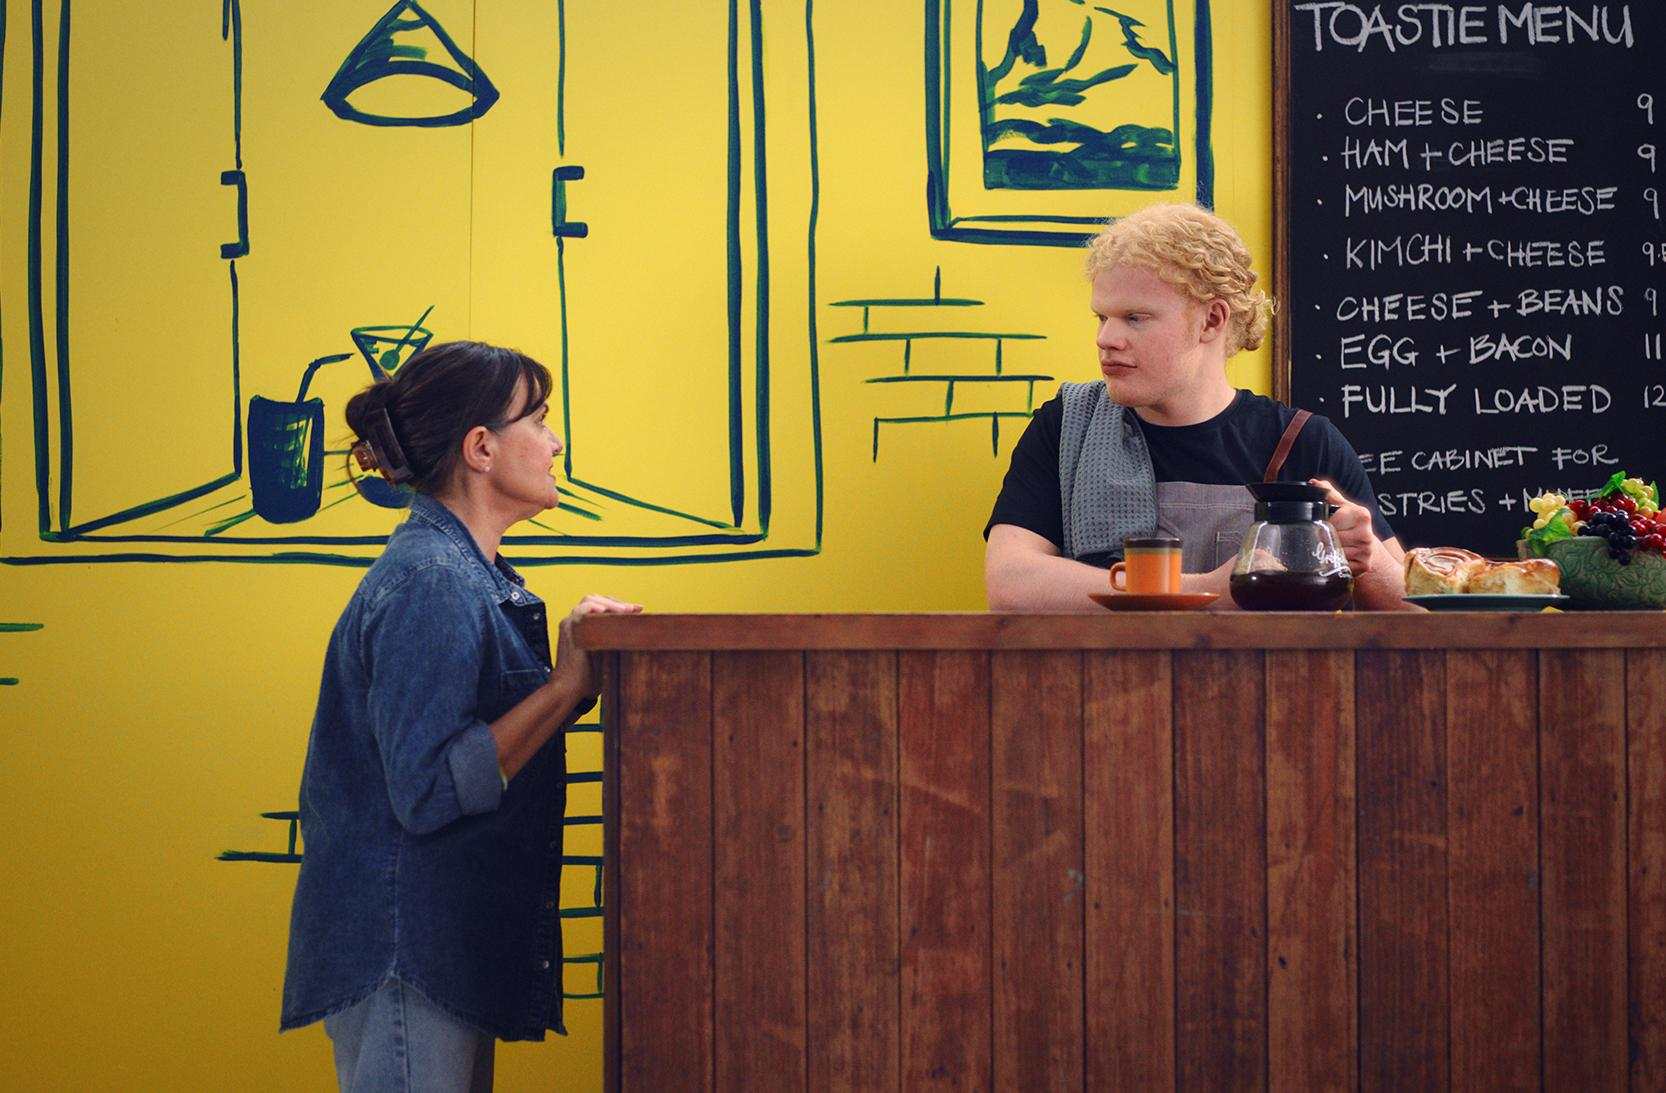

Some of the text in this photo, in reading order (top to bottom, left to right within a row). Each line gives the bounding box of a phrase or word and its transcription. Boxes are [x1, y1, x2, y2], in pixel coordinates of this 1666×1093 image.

[1294, 2, 1634, 52] TOASTIE MENU
[1345, 97, 1483, 126] CHEESE
[1638, 94, 1653, 124] 9
[1341, 136, 1409, 169] HAM
[1449, 138, 1574, 166] CHEESE
[1638, 144, 1655, 172] 9
[1644, 188, 1659, 219] 9
[1347, 234, 1451, 270] KIMCHI
[1488, 240, 1605, 267] CHEESE
[1337, 291, 1482, 322] CHEESE
[1517, 286, 1623, 316] BEANS
[1645, 288, 1656, 316] 9
[1341, 334, 1571, 370] EGG + BACON
[1646, 334, 1661, 359] 11
[1341, 384, 1611, 418] FULLY LOADED
[1358, 445, 1618, 475] EE CABINET FOR
[1378, 489, 1485, 516] STRIES
